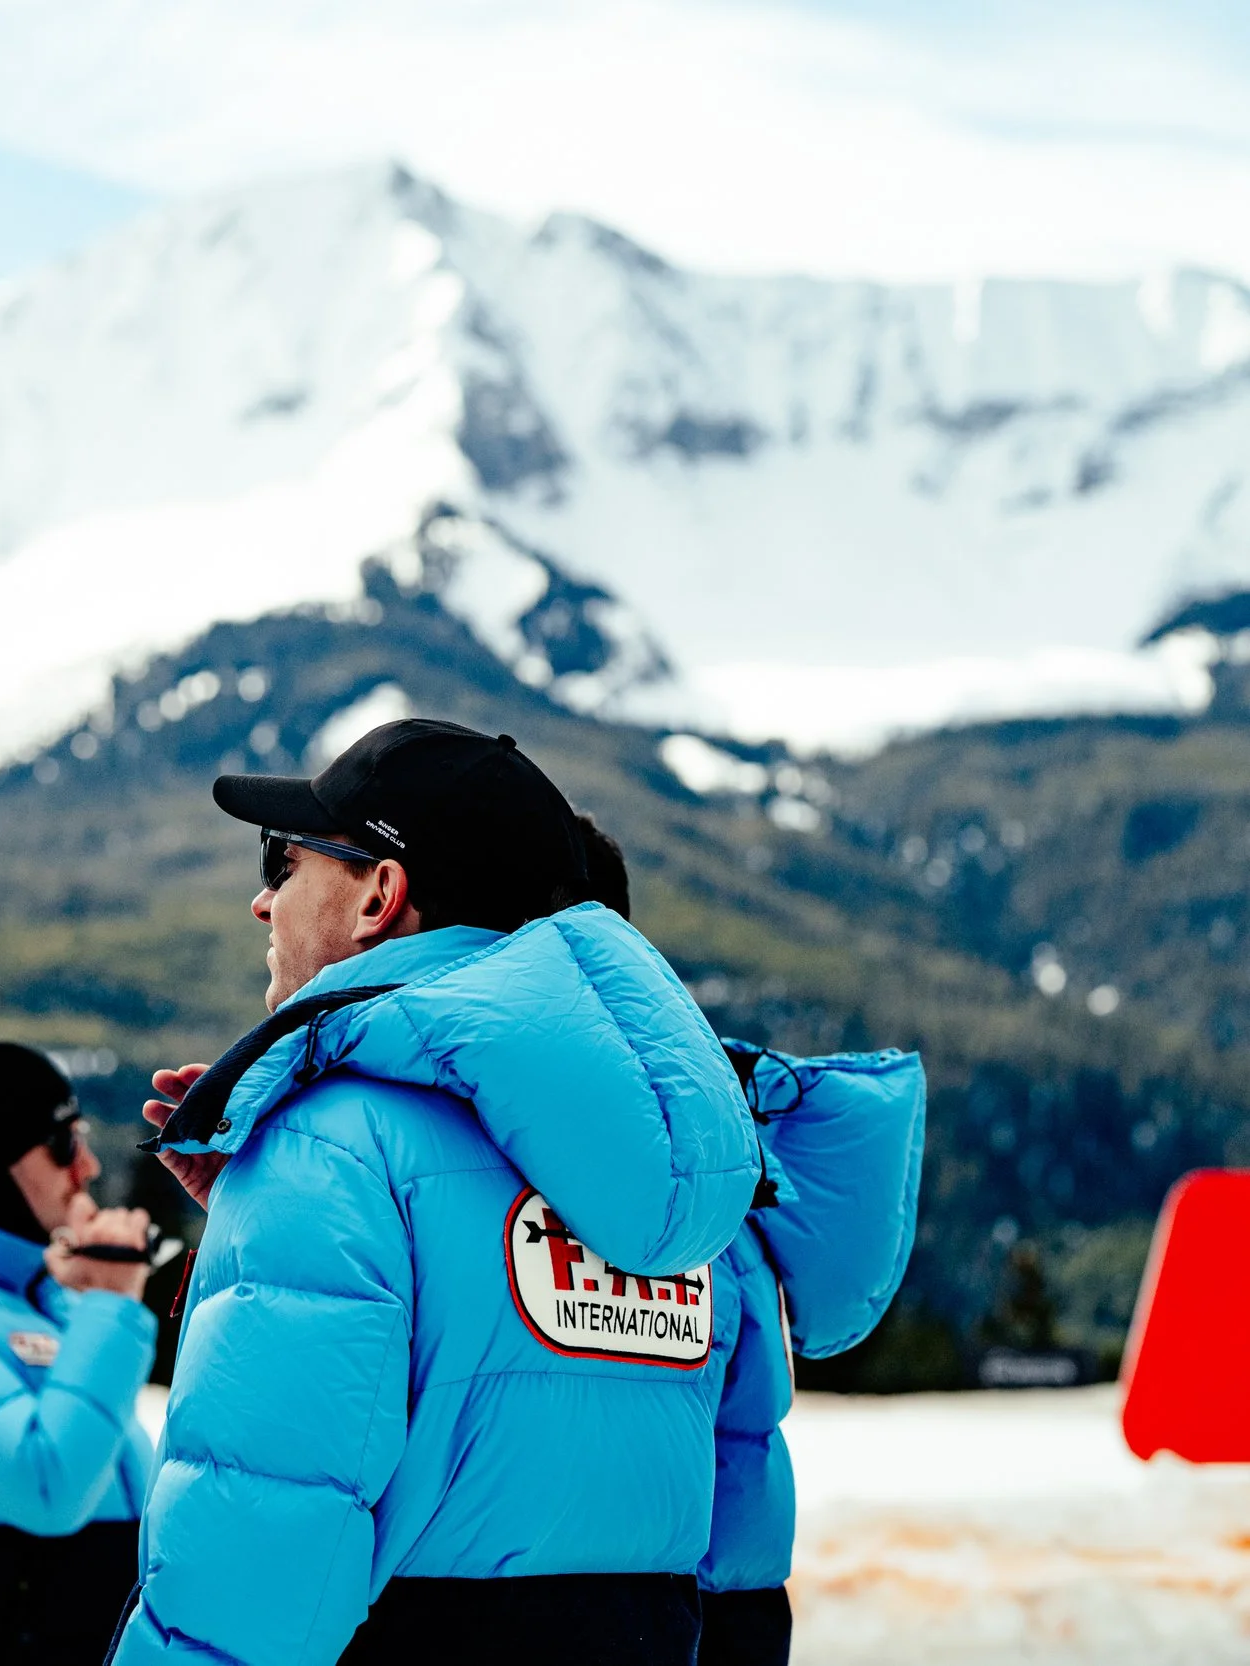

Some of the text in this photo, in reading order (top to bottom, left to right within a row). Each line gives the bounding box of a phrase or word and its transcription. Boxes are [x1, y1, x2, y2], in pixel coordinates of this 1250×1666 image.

[365, 820, 406, 849] DRIVERS CLUB
[378, 820, 399, 836] SINGER
[556, 1299, 704, 1345] INTERNATIONAL
